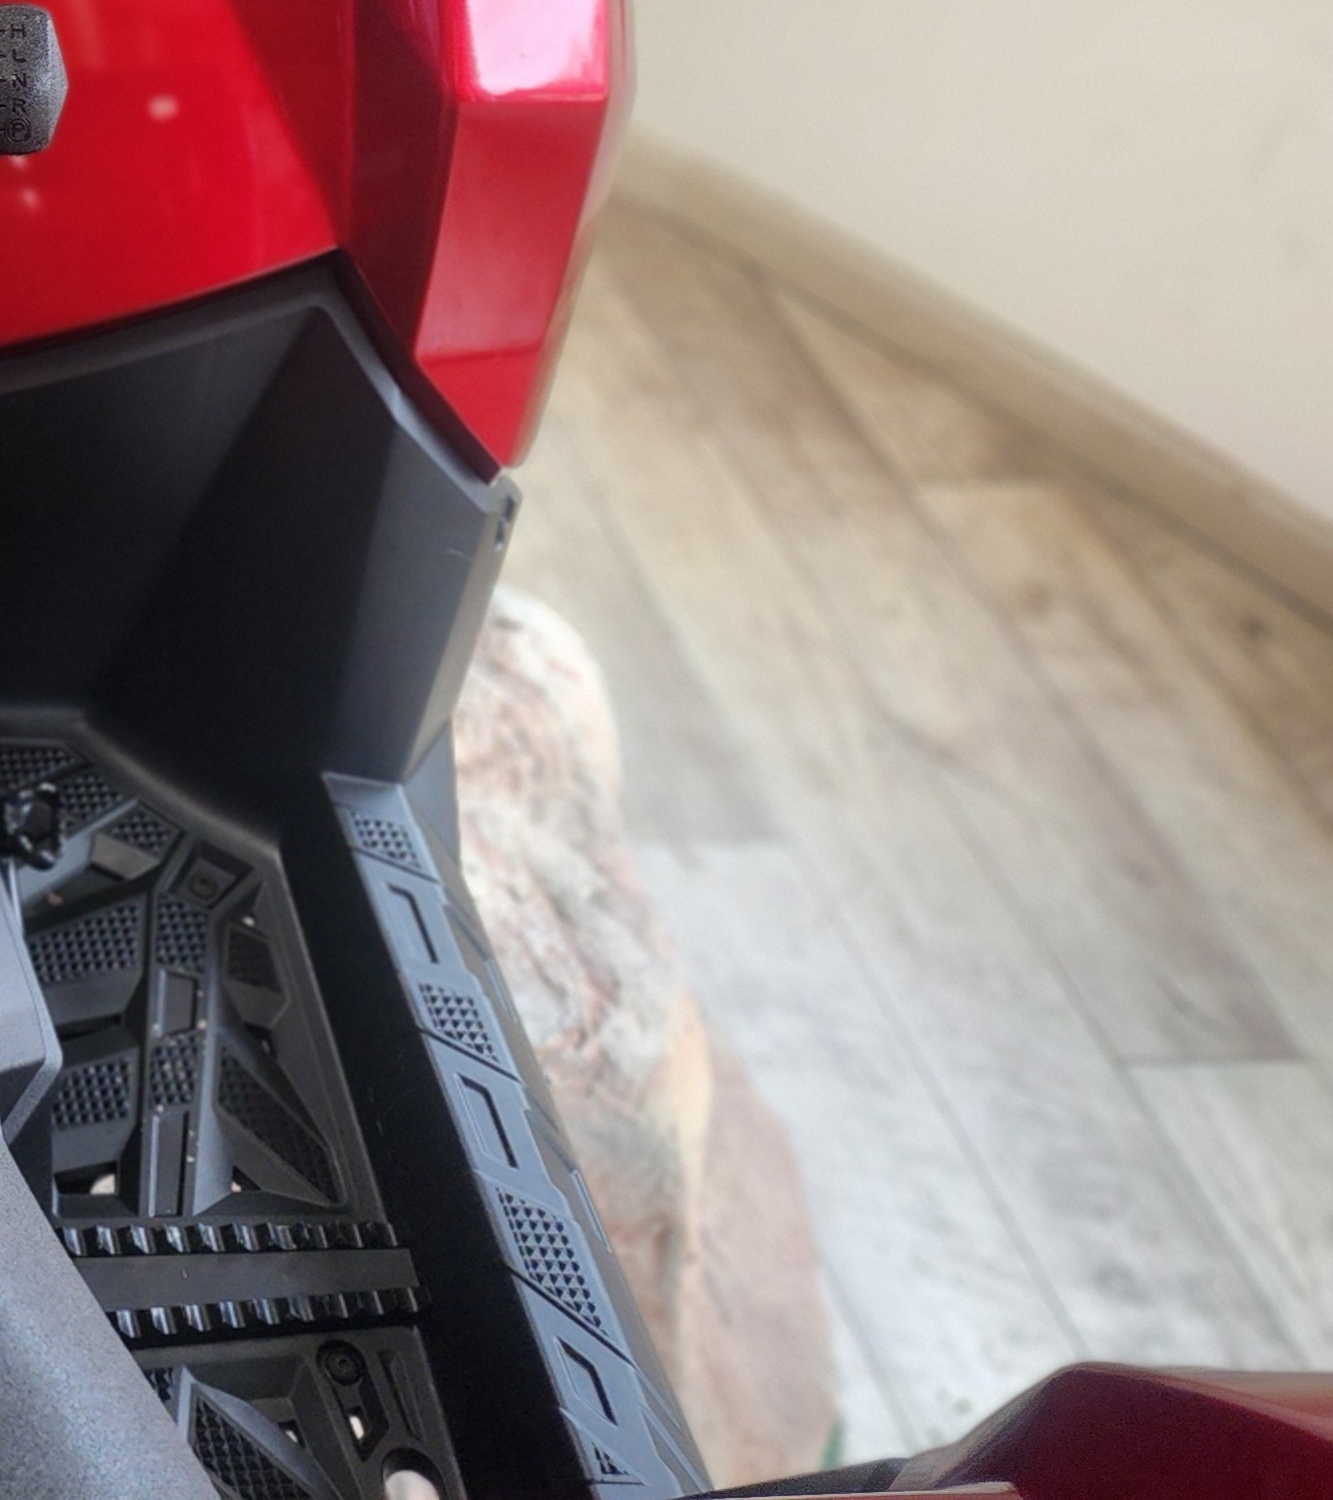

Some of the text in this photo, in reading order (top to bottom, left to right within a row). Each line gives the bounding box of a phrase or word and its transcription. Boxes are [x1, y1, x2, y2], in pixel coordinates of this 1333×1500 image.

[11, 24, 25, 38] H
[11, 49, 26, 62] L
[12, 74, 27, 88] N
[11, 99, 26, 113] R
